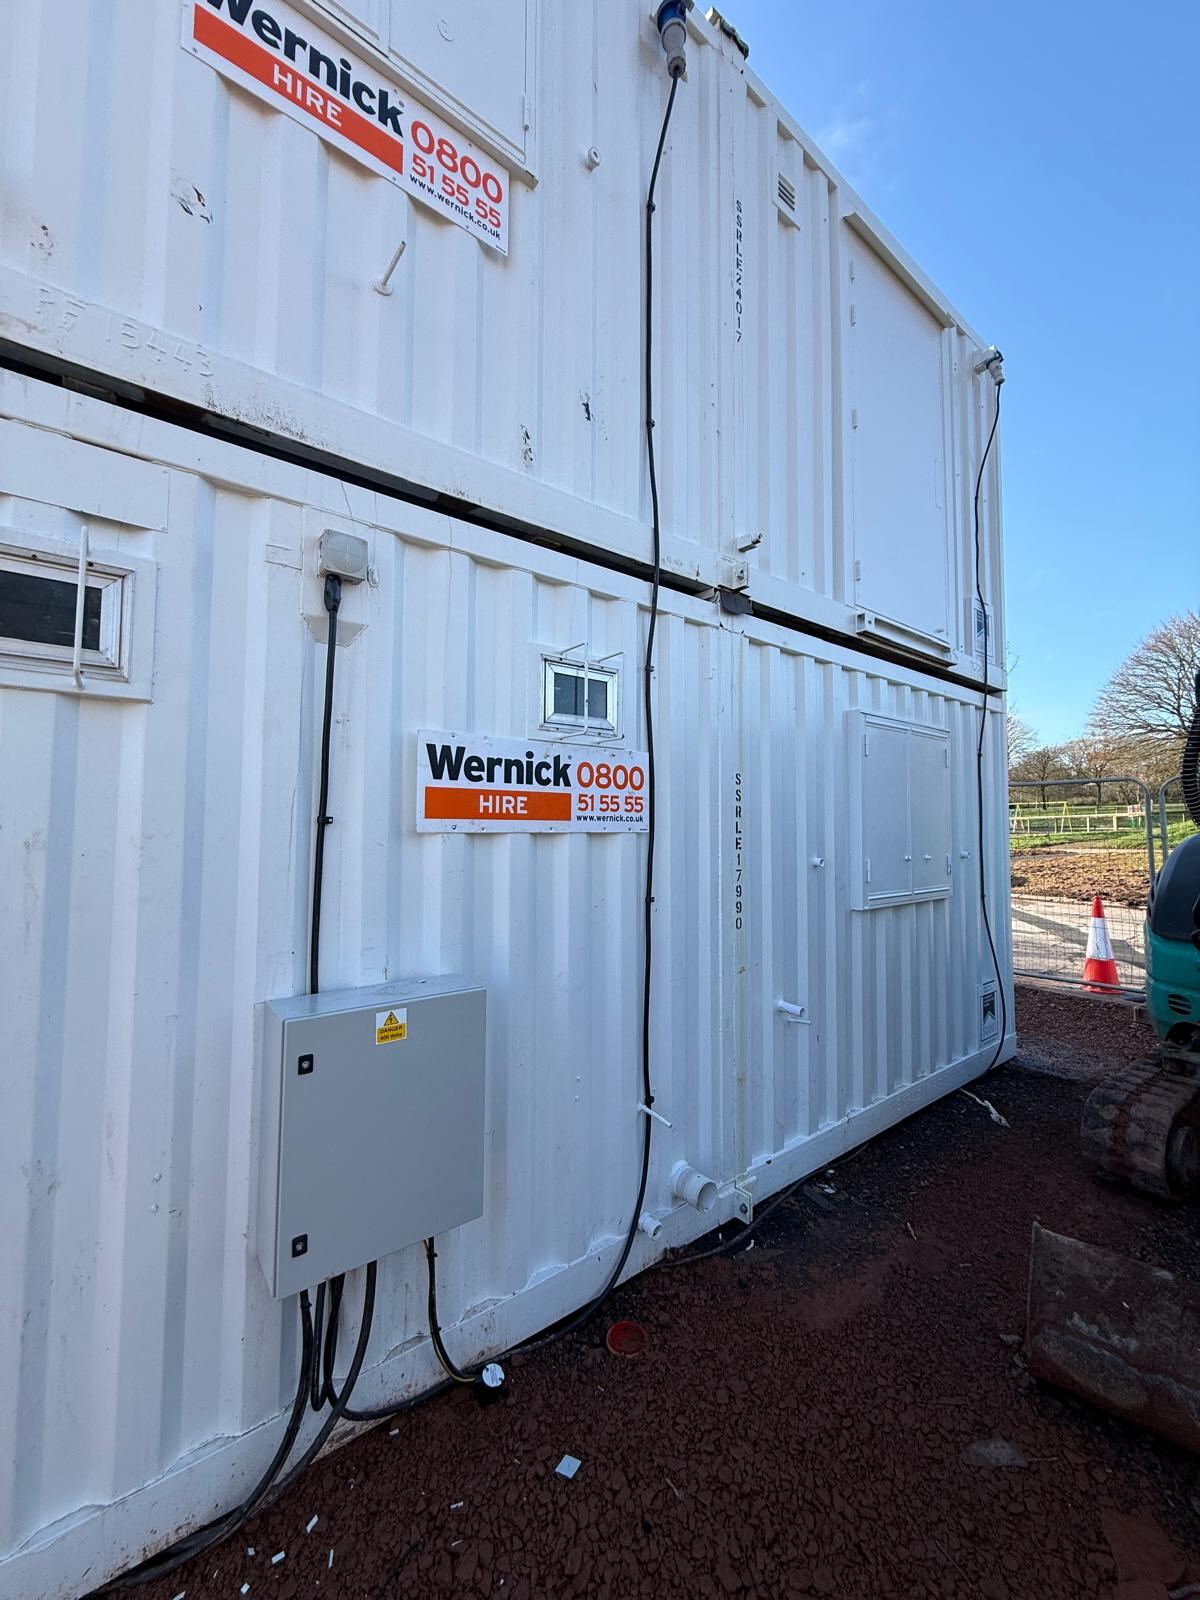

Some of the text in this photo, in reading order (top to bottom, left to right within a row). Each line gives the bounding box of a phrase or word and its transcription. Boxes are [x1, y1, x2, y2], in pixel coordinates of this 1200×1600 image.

[273, 63, 342, 127] HIRE
[411, 120, 503, 204] 0800
[409, 174, 502, 240] www.wernick.co.uk
[412, 153, 502, 229] 51 55 55
[735, 199, 743, 343] SSRLE24017
[425, 743, 572, 788] Wernick
[576, 761, 645, 791] 0800
[479, 795, 528, 815] HIRE
[576, 814, 644, 823] www.wernick.co.uk
[577, 793, 644, 813] 51 55 55
[380, 1025, 403, 1034] DANGER
